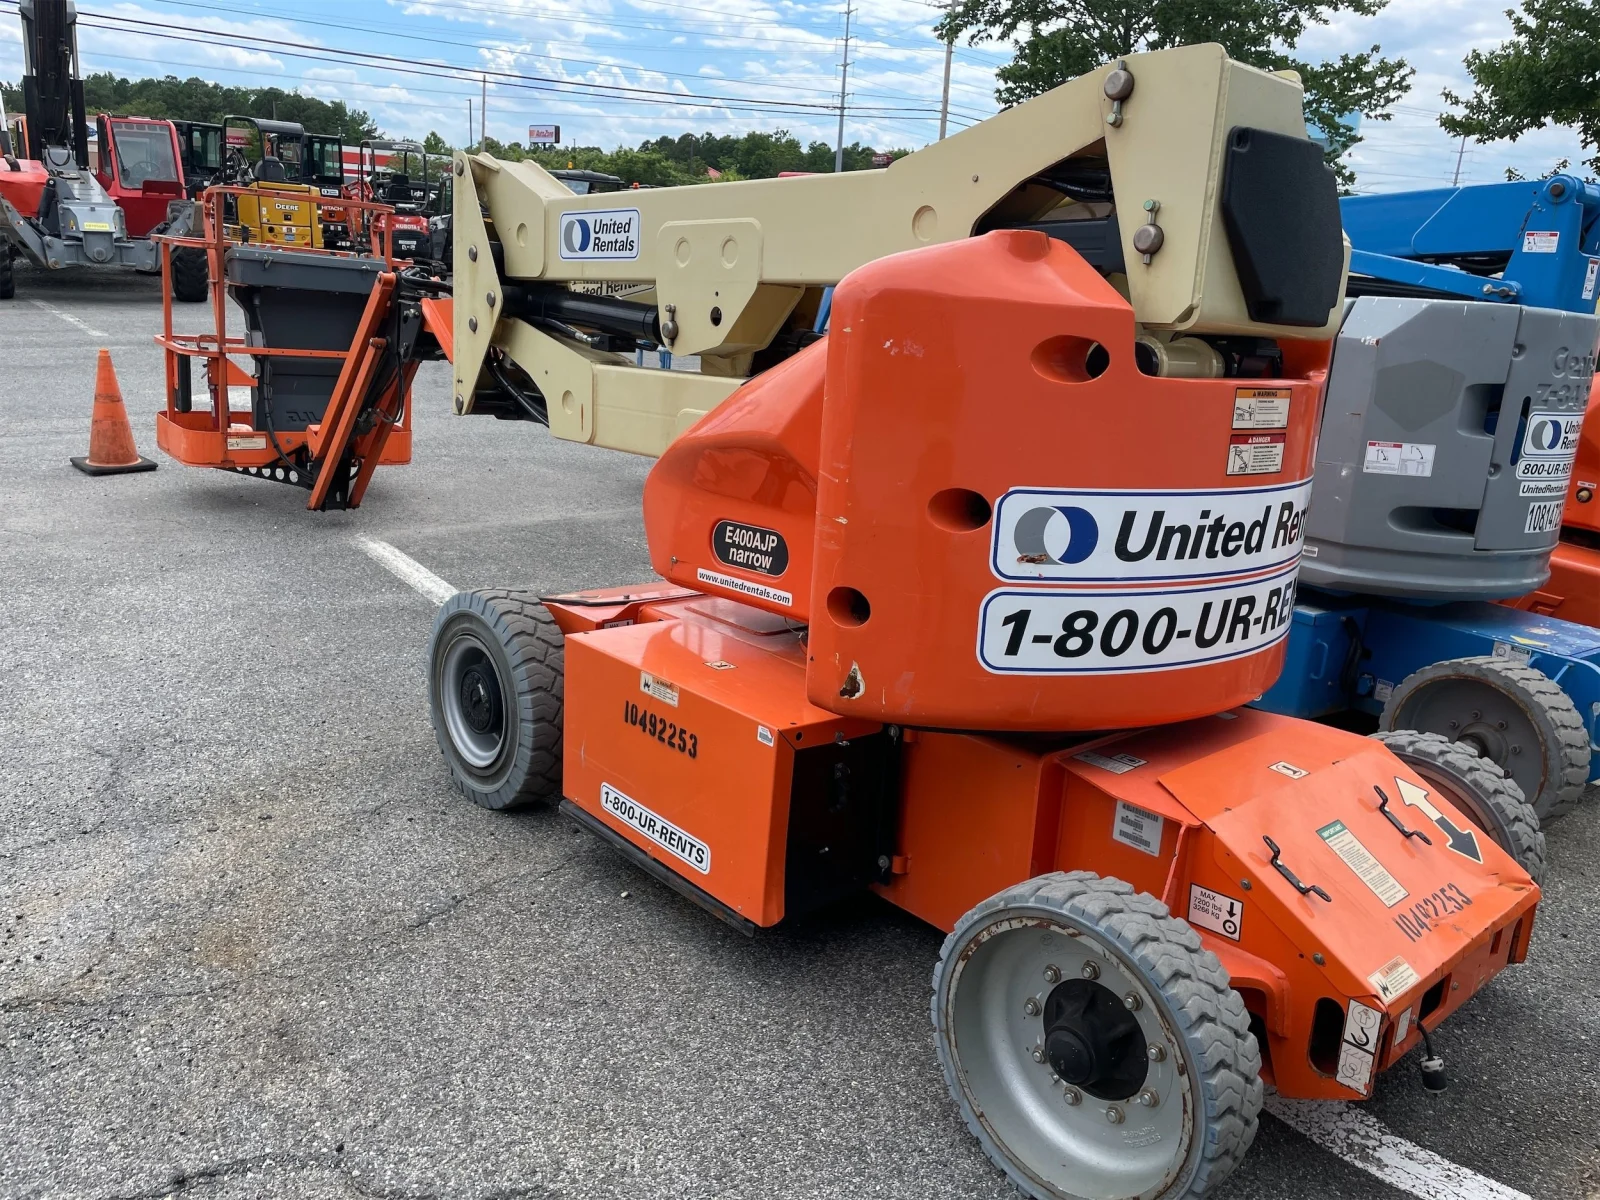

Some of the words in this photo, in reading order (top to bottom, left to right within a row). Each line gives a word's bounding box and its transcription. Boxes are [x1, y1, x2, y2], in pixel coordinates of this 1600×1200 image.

[275, 203, 300, 211] DEERE
[395, 223, 417, 231] KUBOTA
[593, 217, 632, 235] United
[592, 236, 635, 252] Rentals
[725, 526, 778, 552] E400AJP
[1114, 505, 1272, 562] United
[729, 547, 773, 569] narrow
[699, 572, 790, 604] www.unitedrentals.com
[624, 700, 698, 759] 10492253
[604, 791, 705, 864] 1-800-UR-RENTS
[1321, 823, 1343, 838] IMPORTANT
[1193, 896, 1210, 907] 7200
[1212, 903, 1222, 912] lbs
[1200, 891, 1216, 902] MAX
[1193, 903, 1210, 914] 3266
[1211, 911, 1220, 920] kg
